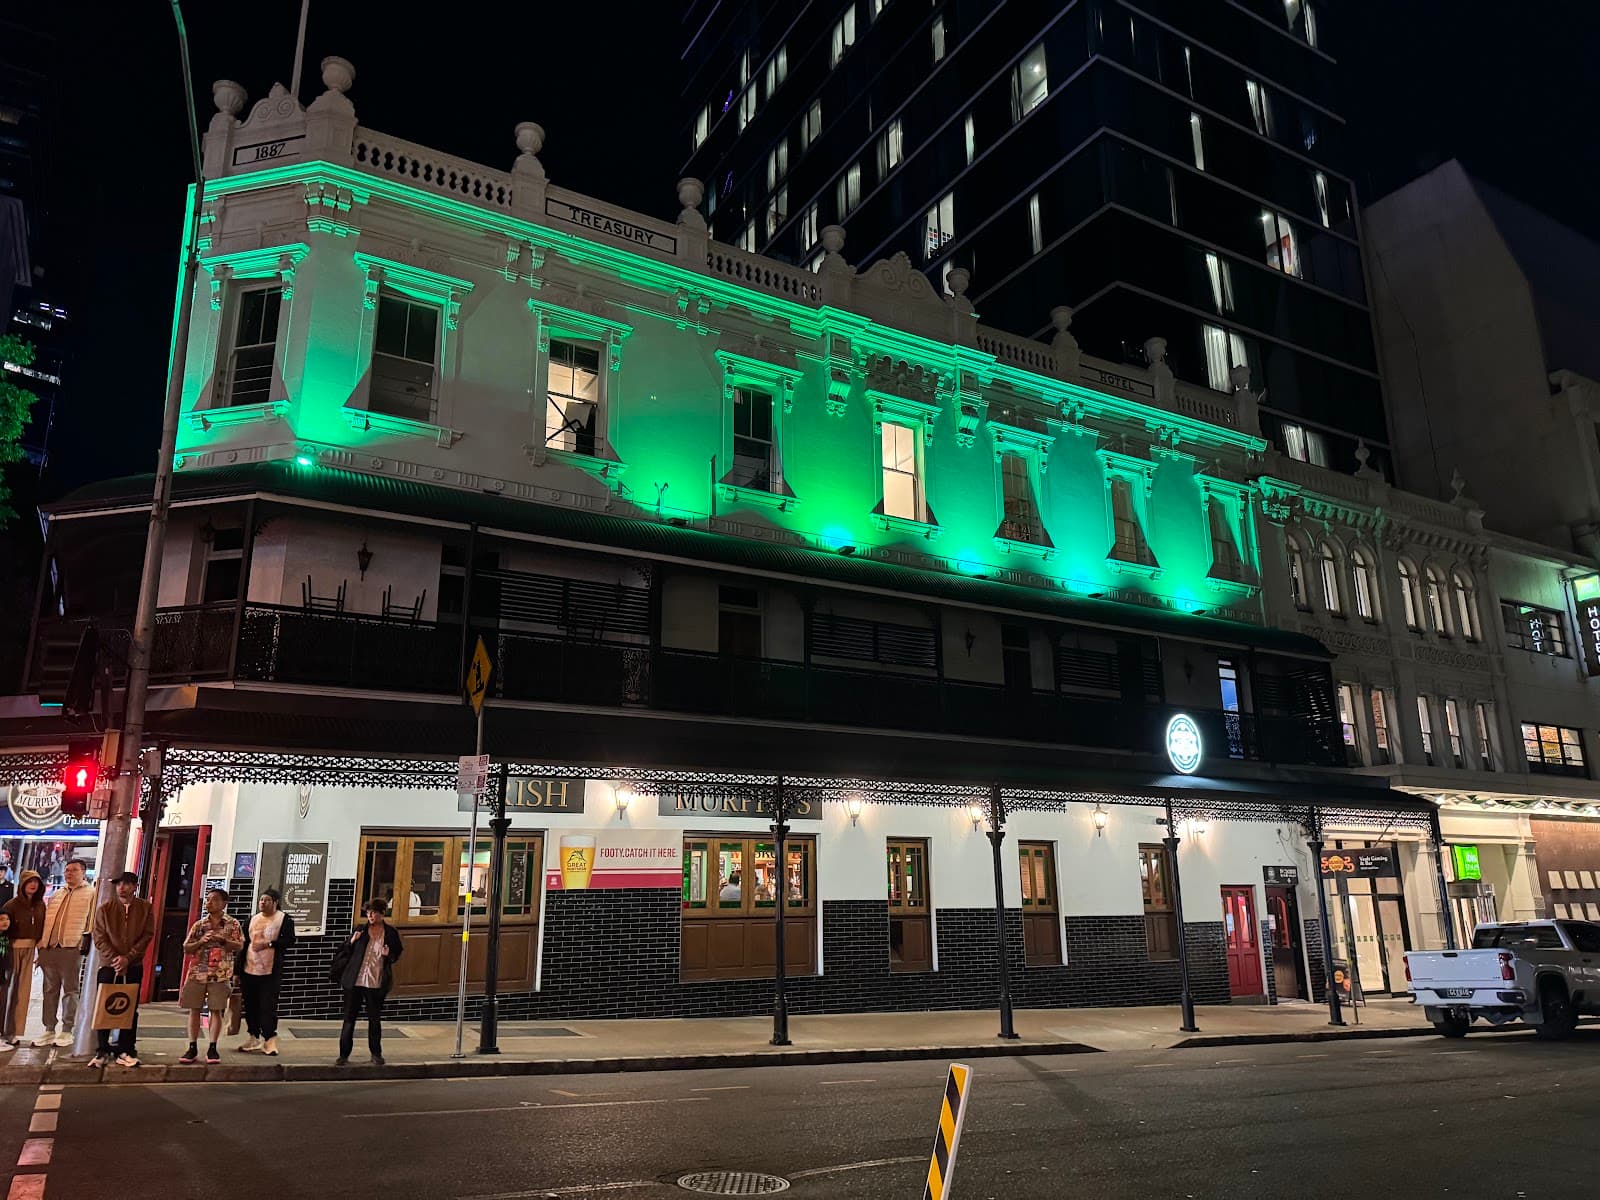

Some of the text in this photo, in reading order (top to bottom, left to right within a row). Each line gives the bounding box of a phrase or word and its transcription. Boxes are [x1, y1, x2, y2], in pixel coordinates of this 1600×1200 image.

[255, 143, 286, 160] 1887
[569, 207, 654, 244] TREASURY
[1100, 372, 1135, 391] HOTEL
[1587, 605, 1600, 665] HOTE
[288, 854, 323, 864] COUNTRY
[649, 848, 656, 858] IT
[287, 864, 310, 874] CRAIC
[286, 874, 309, 884] NIGHT
[107, 997, 128, 1010] JD
